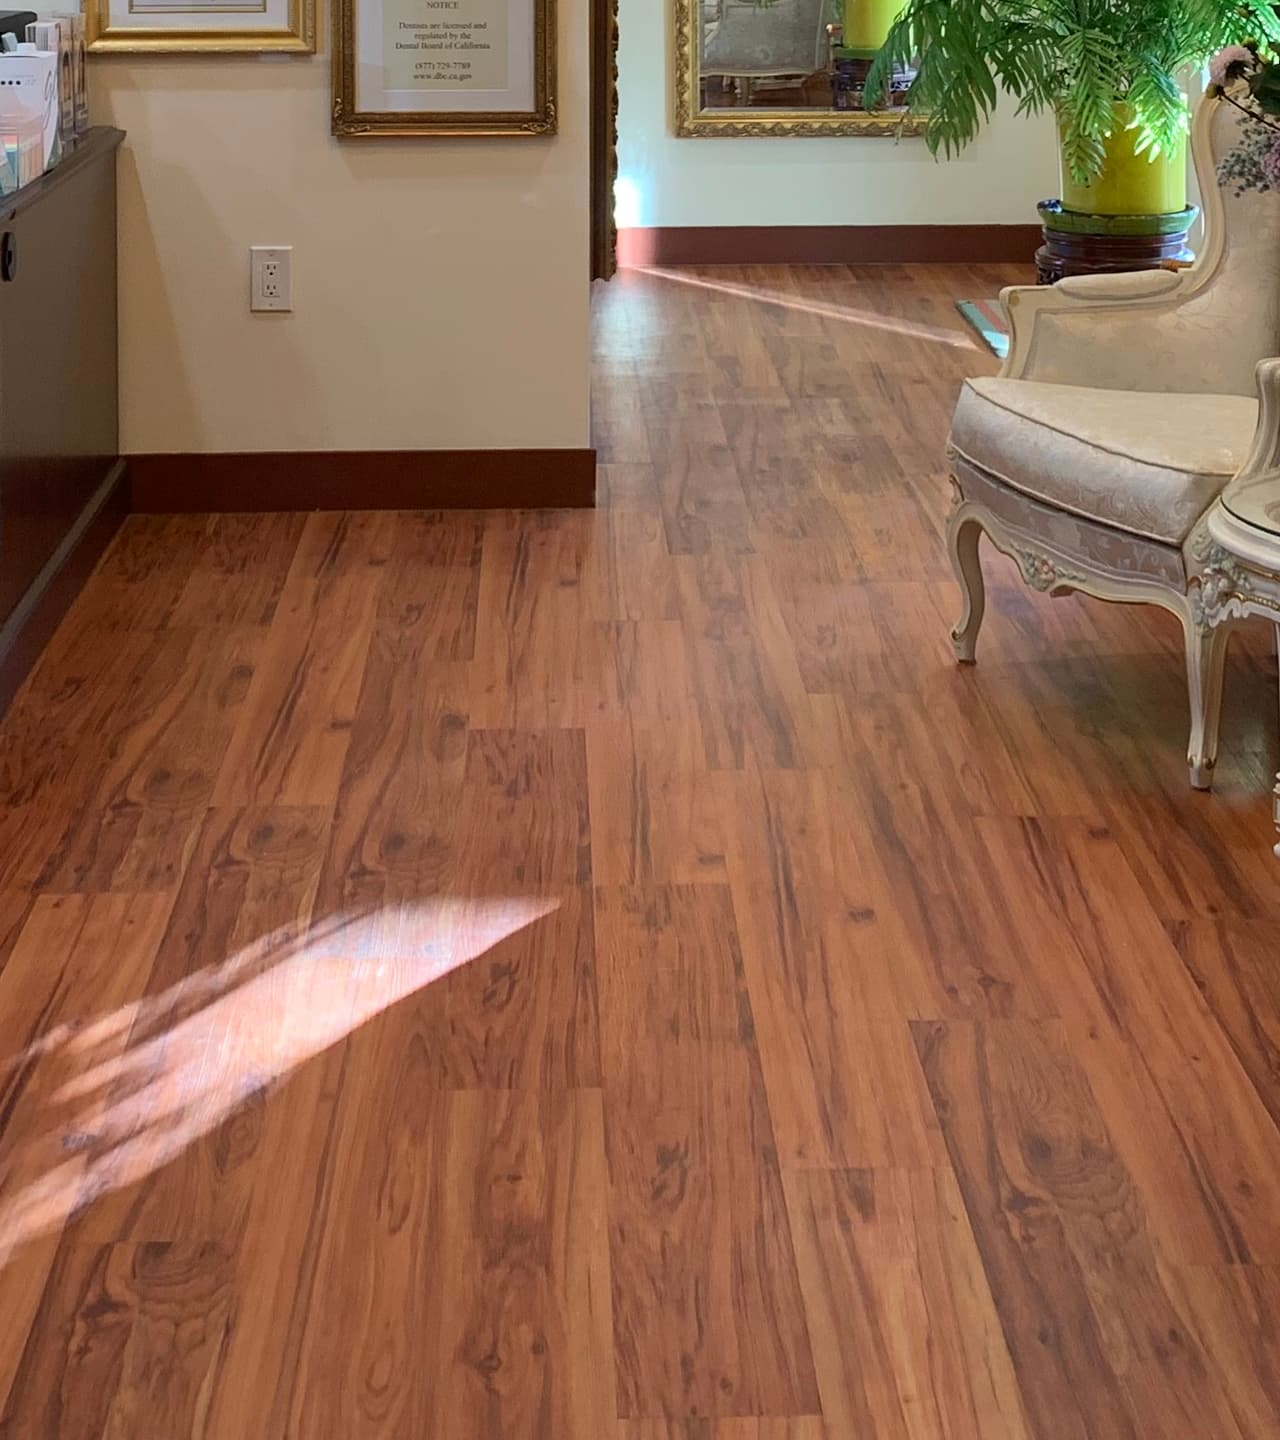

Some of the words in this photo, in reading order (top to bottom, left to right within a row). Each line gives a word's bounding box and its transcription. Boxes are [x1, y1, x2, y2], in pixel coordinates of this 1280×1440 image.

[426, 1, 459, 9] NOTICE
[474, 22, 487, 30] and
[414, 32, 447, 41] regulated
[449, 32, 458, 41] by
[460, 32, 472, 40] the
[395, 42, 419, 50] Dental
[421, 42, 443, 50] Board
[445, 42, 453, 50] of
[454, 42, 490, 50] California
